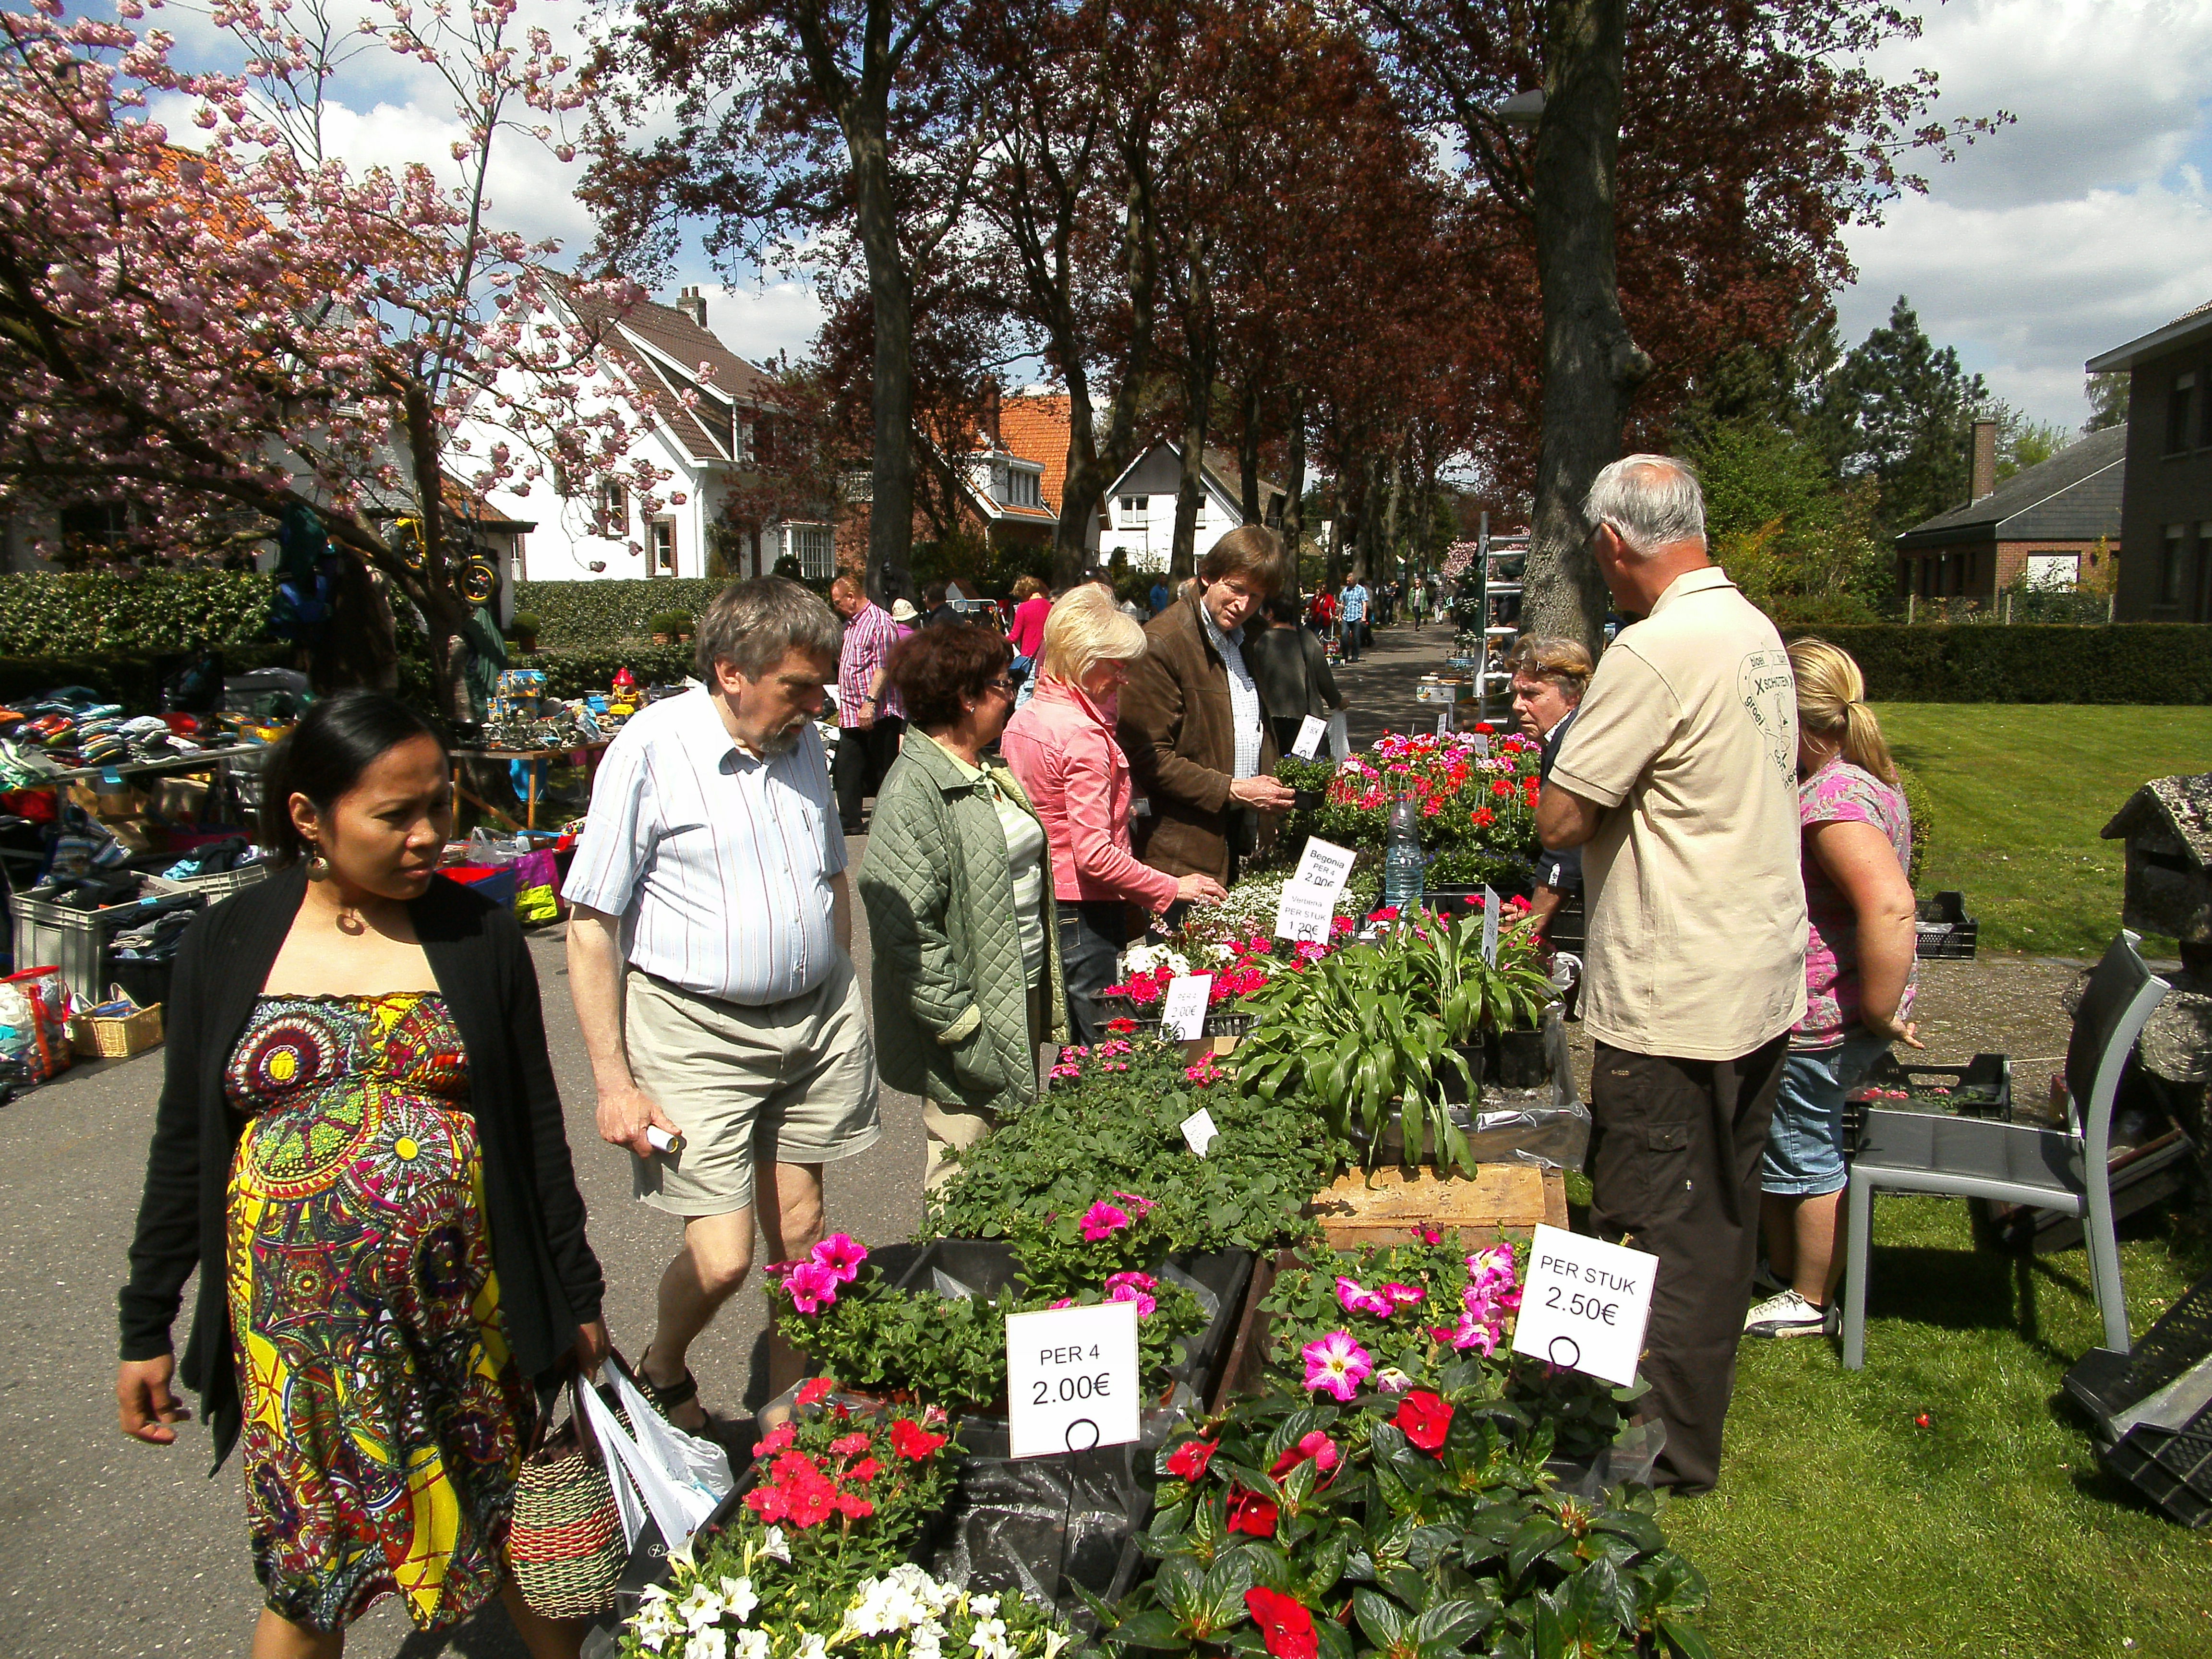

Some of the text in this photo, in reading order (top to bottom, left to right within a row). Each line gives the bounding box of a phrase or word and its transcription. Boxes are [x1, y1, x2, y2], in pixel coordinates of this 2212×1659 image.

[1744, 696, 1764, 726] groei
[1310, 850, 1345, 868] Begonia
[1313, 863, 1329, 874] PER
[1305, 872, 1334, 887] 2.00€
[1292, 896, 1322, 907] Verbena
[1285, 907, 1326, 921] PER STUK
[1289, 921, 1319, 935] 1.20€
[1541, 1255, 1636, 1295] PER STUK
[1545, 1286, 1619, 1325] 2.50€
[1041, 1344, 1100, 1366] PER 4
[1033, 1372, 1110, 1405] 2.00€
